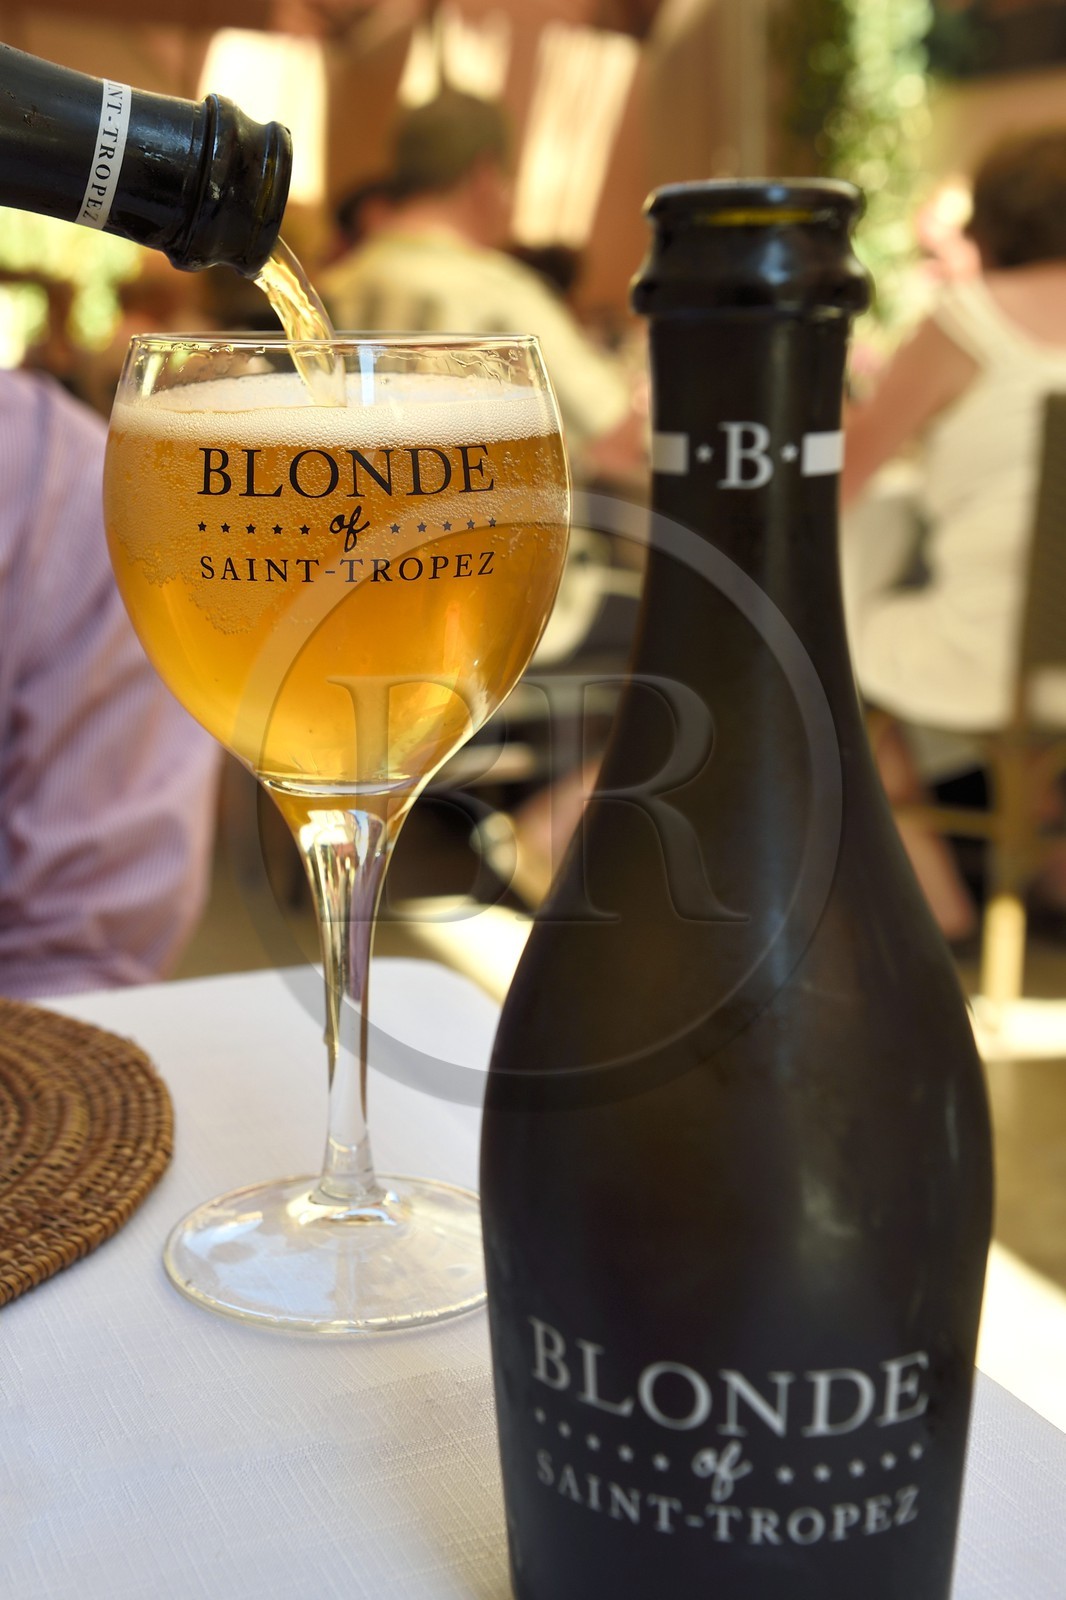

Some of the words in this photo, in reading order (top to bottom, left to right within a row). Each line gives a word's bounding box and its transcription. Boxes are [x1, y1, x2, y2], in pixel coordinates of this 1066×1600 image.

[197, 445, 494, 498] BLONDE
[716, 421, 774, 490] B
[329, 505, 370, 552] of
[201, 551, 495, 583] SAINT-TROPEZ
[529, 1316, 930, 1438] BLONDE
[537, 1449, 919, 1545] SAINT-TROPEZ
[692, 1440, 753, 1502] of
